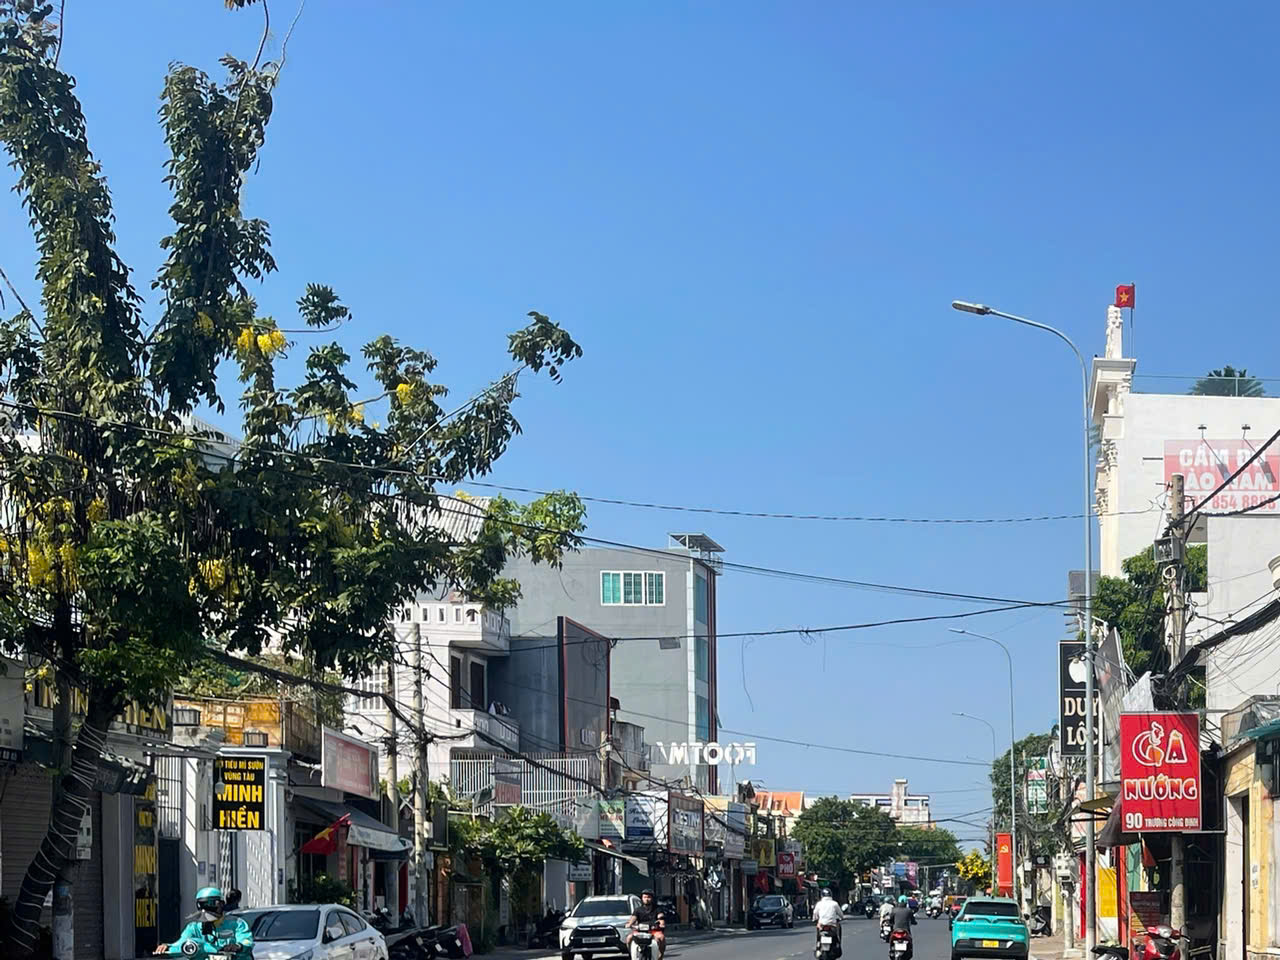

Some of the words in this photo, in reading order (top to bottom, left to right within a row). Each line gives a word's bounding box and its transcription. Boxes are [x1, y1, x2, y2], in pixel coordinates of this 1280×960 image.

[217, 783, 263, 803] MINH
[1124, 772, 1198, 801] NƯỚNG
[1125, 812, 1143, 829] 90
